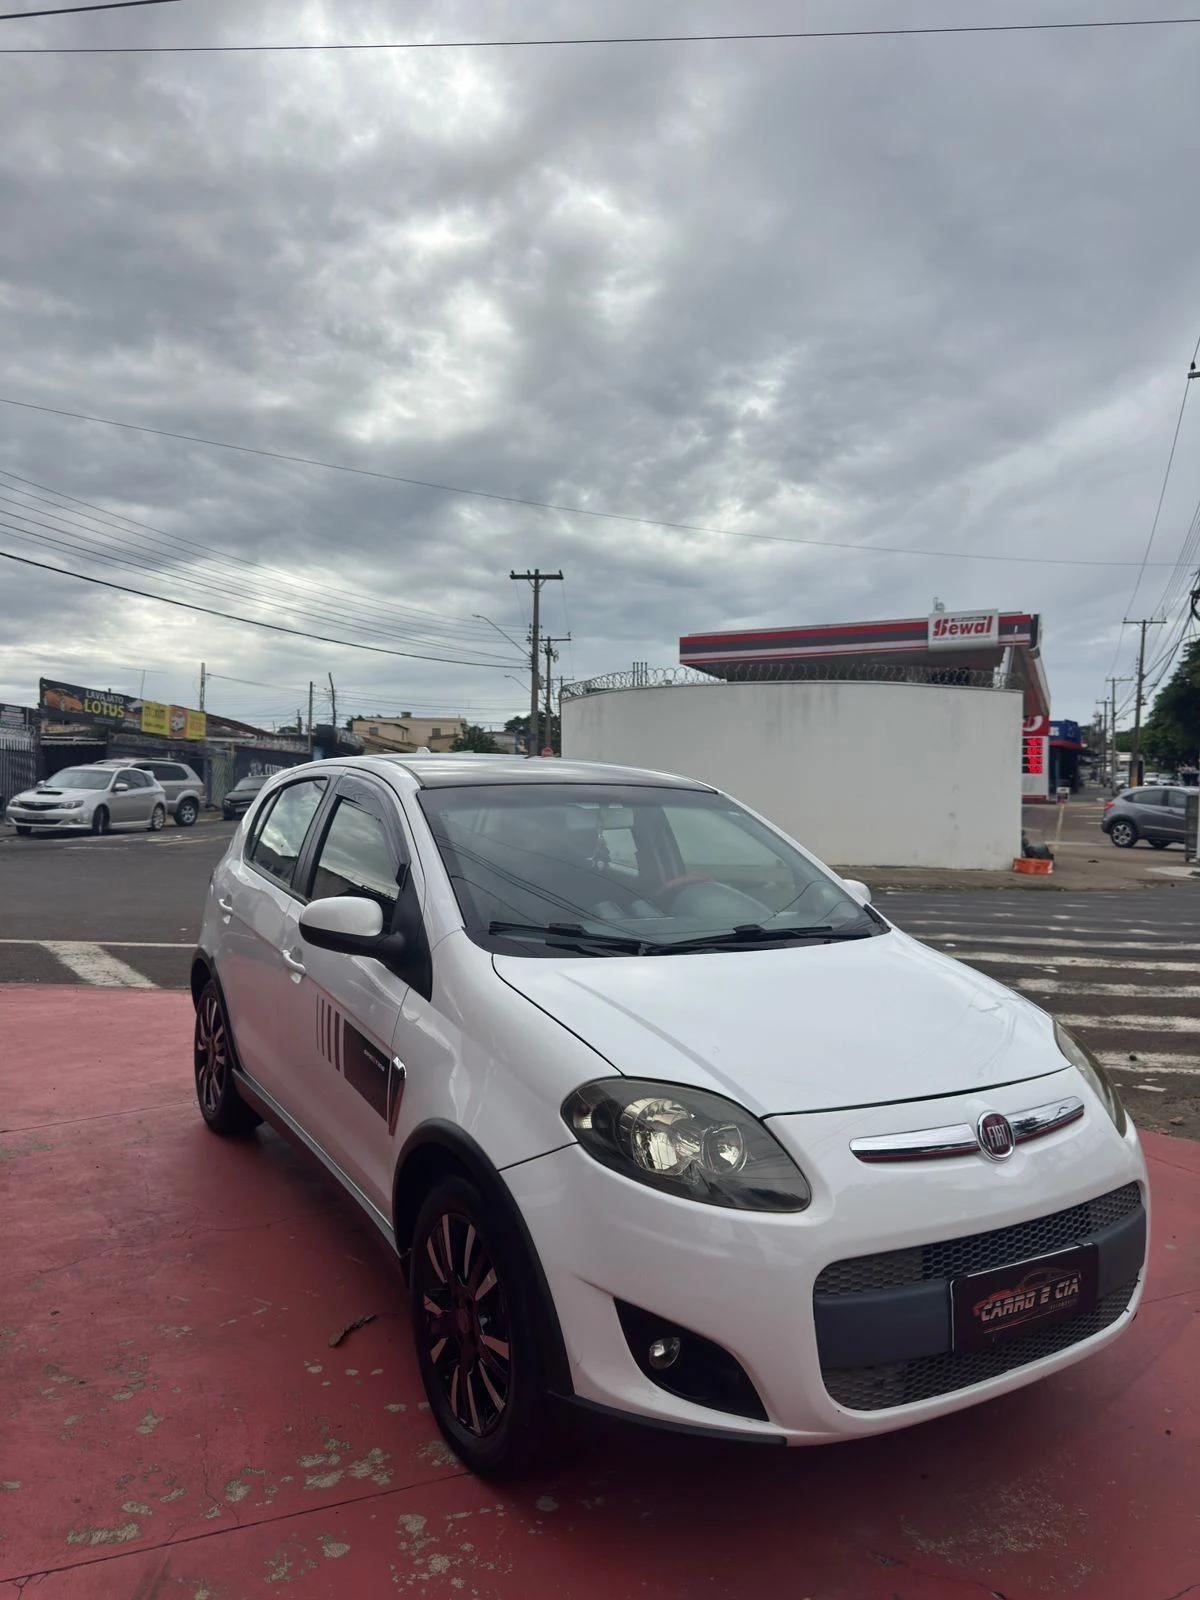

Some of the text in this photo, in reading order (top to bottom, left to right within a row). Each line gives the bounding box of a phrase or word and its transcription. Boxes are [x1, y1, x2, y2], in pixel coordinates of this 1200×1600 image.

[933, 616, 993, 637] Sewal
[86, 690, 124, 704] LAVA JATO
[84, 699, 125, 718] LOTUS
[987, 1124, 1008, 1147] FIAT
[981, 1291, 1036, 1322] CARRO
[1040, 1286, 1051, 1304] E
